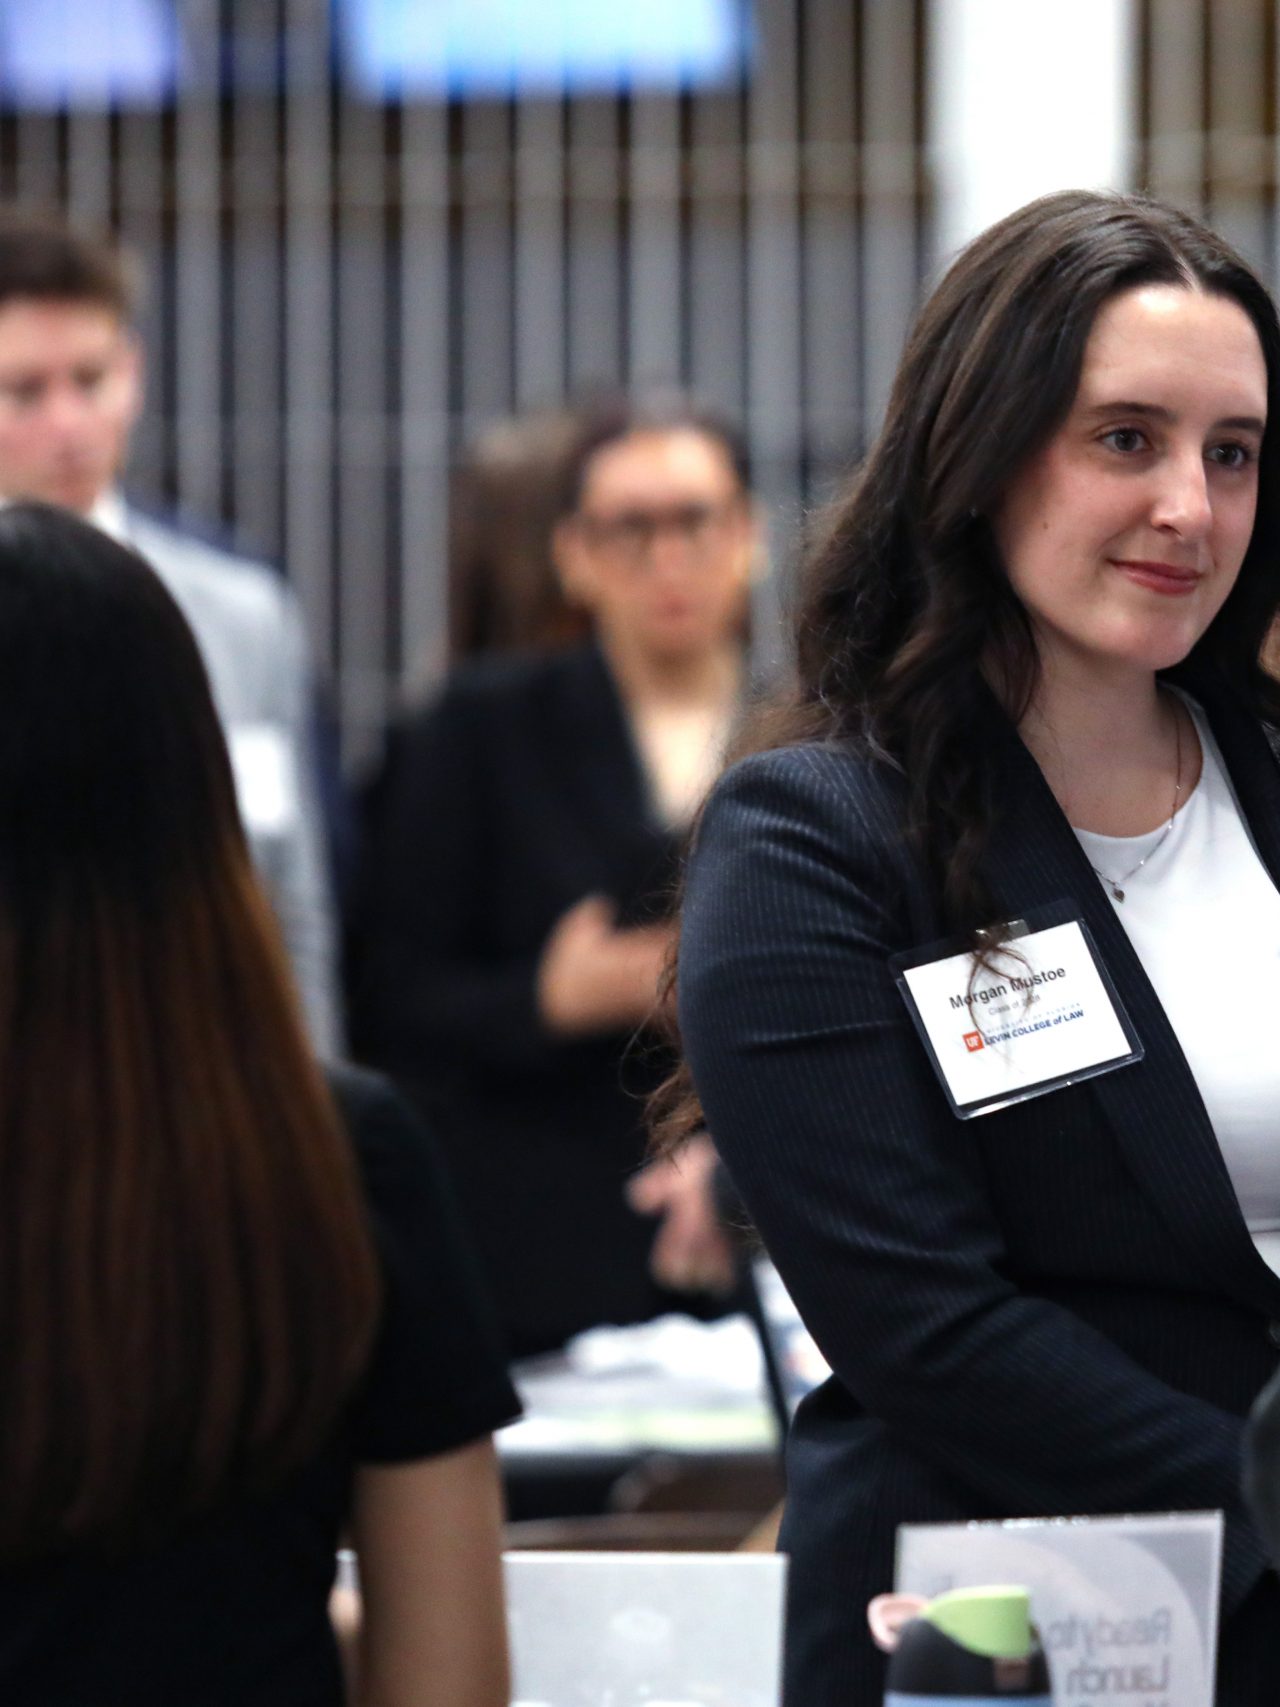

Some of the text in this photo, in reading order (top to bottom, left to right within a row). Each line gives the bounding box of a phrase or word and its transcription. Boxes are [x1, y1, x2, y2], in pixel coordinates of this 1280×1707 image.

[949, 984, 1007, 1010] Morgan
[1010, 967, 1066, 992] Mustoe
[1012, 1019, 1052, 1038] COLLEGE
[1053, 1015, 1062, 1025] of
[1063, 1009, 1085, 1022] LAW
